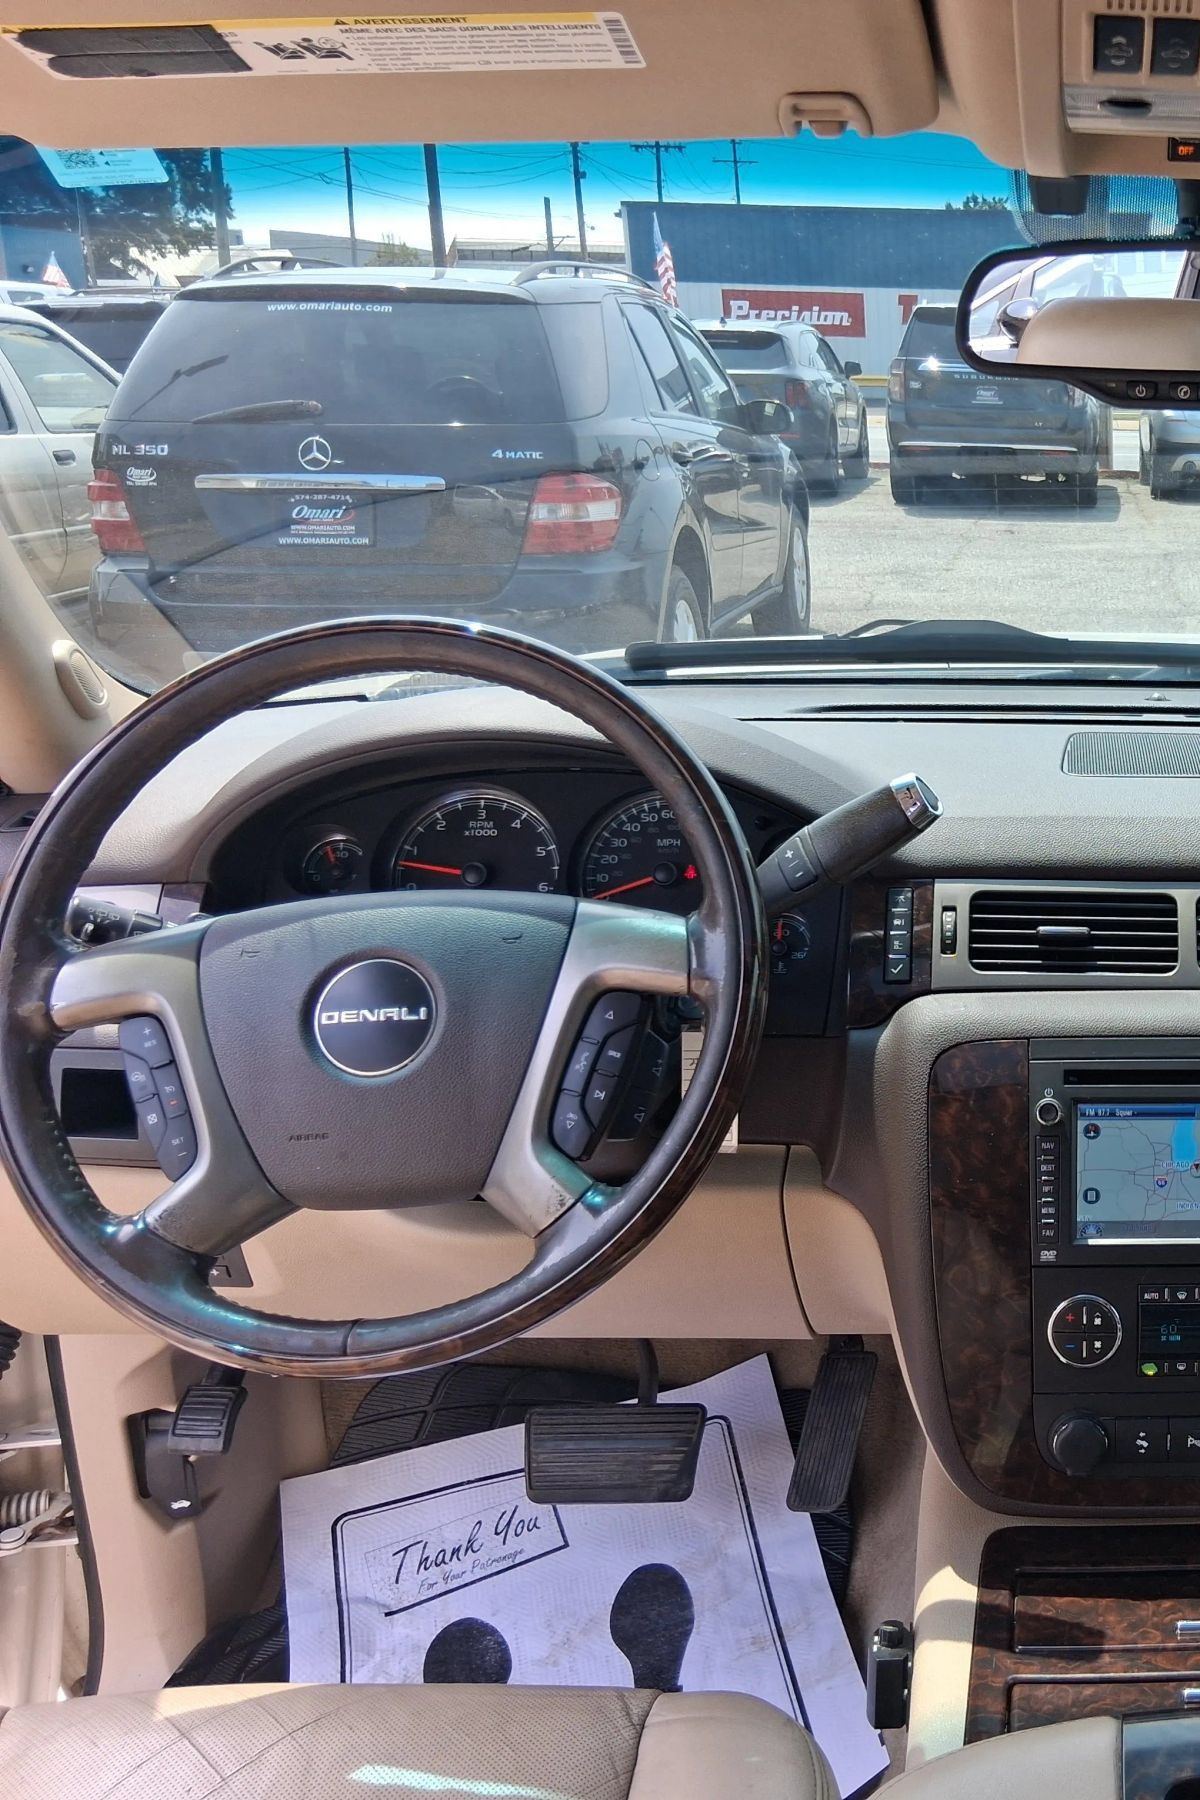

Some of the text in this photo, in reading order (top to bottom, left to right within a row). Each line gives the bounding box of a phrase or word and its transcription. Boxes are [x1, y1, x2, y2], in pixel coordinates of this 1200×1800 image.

[353, 16, 468, 25] AVERTISSEMENT
[529, 23, 601, 31] INTELLIGENTS
[1178, 145, 1194, 156] OFF
[267, 302, 393, 313] www.omariauto.com
[729, 300, 851, 326] Precision
[112, 444, 168, 456] ML 350
[291, 505, 346, 519] Omari
[278, 537, 369, 545] WWW.OMARIAUTO.COM
[477, 809, 487, 820] 3
[641, 813, 659, 822] 50
[436, 820, 446, 831] 2
[469, 821, 494, 829] RPM
[511, 819, 522, 829] 4
[622, 823, 641, 832] 40
[610, 838, 627, 848] 30
[656, 838, 680, 847] MPH
[536, 846, 546, 857] 5
[600, 855, 618, 864] 20
[596, 873, 609, 883] 10
[321, 1007, 428, 1024] DENALI
[1085, 1108, 1095, 1116] FM
[171, 1136, 184, 1146] SET
[1143, 1292, 1159, 1300] AUTO
[1160, 1324, 1177, 1334] 60
[392, 1504, 541, 1584] Thank You
[417, 1547, 525, 1594] For Your Patronage
